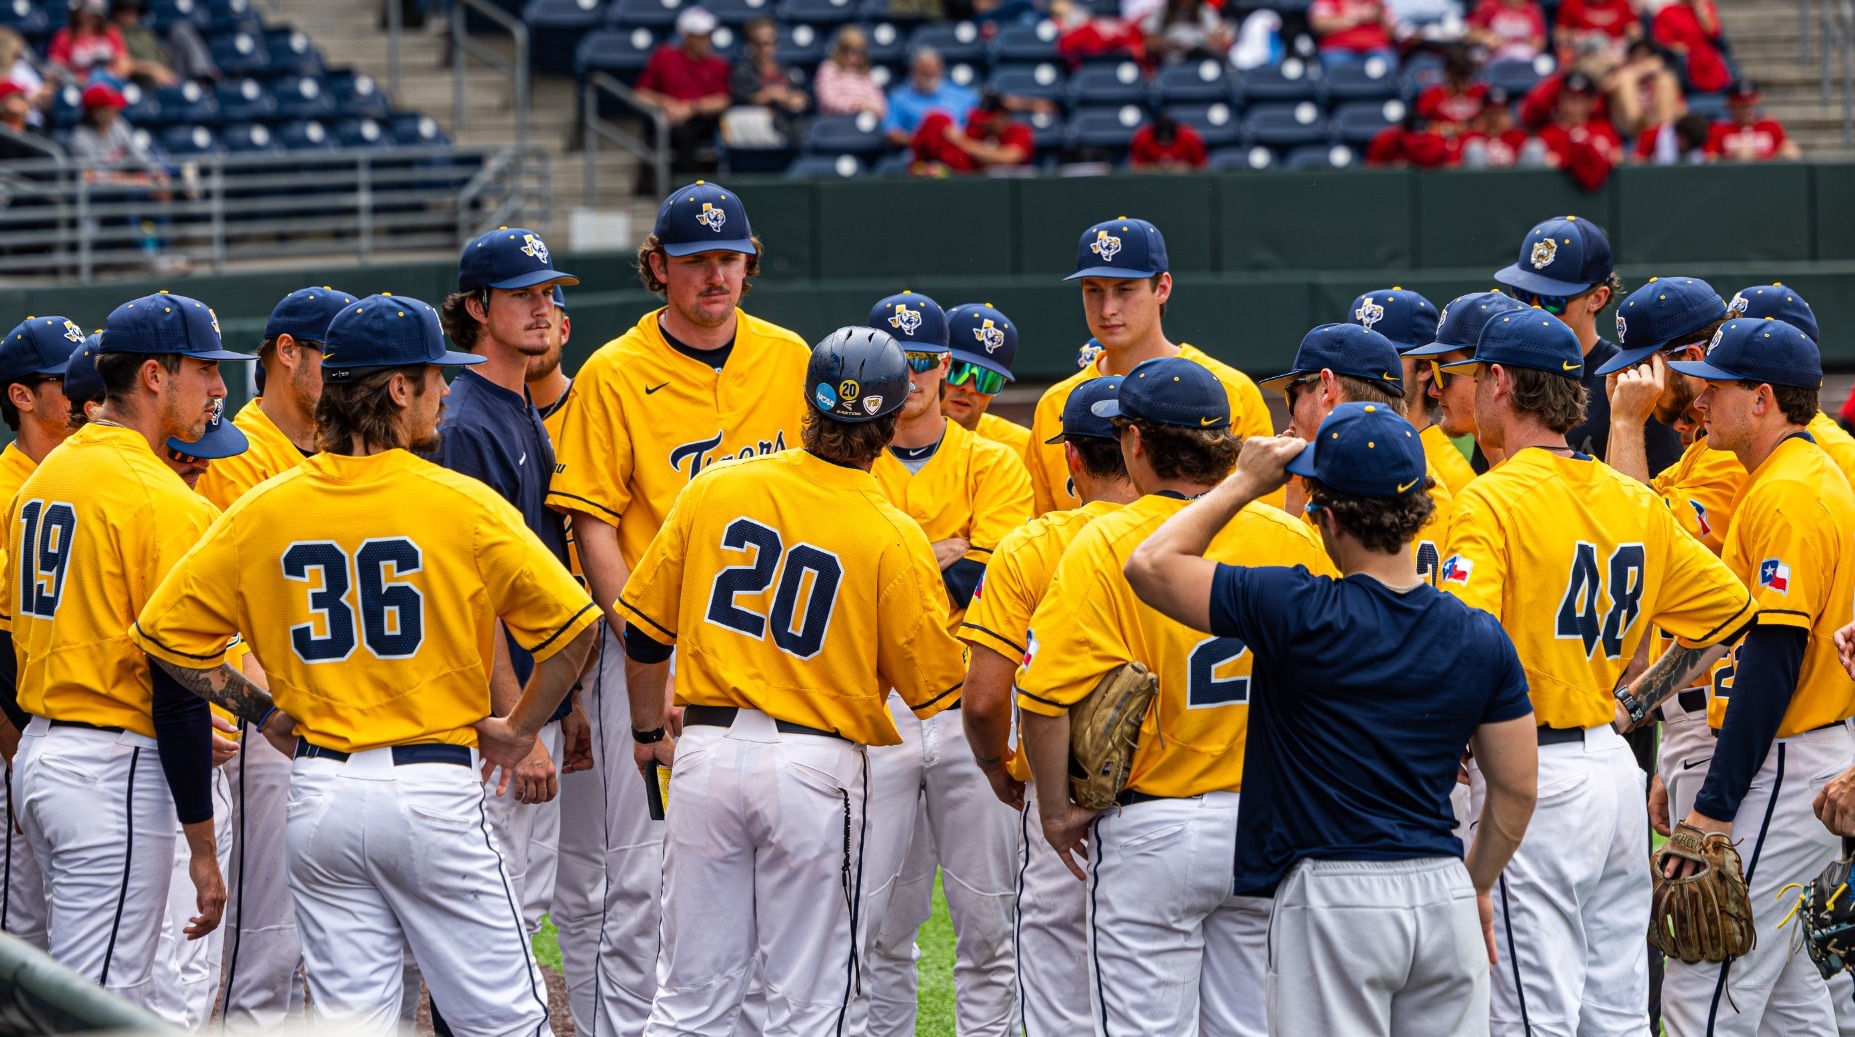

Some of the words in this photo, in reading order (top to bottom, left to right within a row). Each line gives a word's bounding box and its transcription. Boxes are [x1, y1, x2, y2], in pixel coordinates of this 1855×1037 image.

[816, 392, 834, 407] NCAA
[842, 383, 857, 397] 20
[20, 498, 77, 620] 19
[280, 536, 425, 664] 36
[704, 515, 844, 661] 20
[1554, 540, 1646, 662] 48
